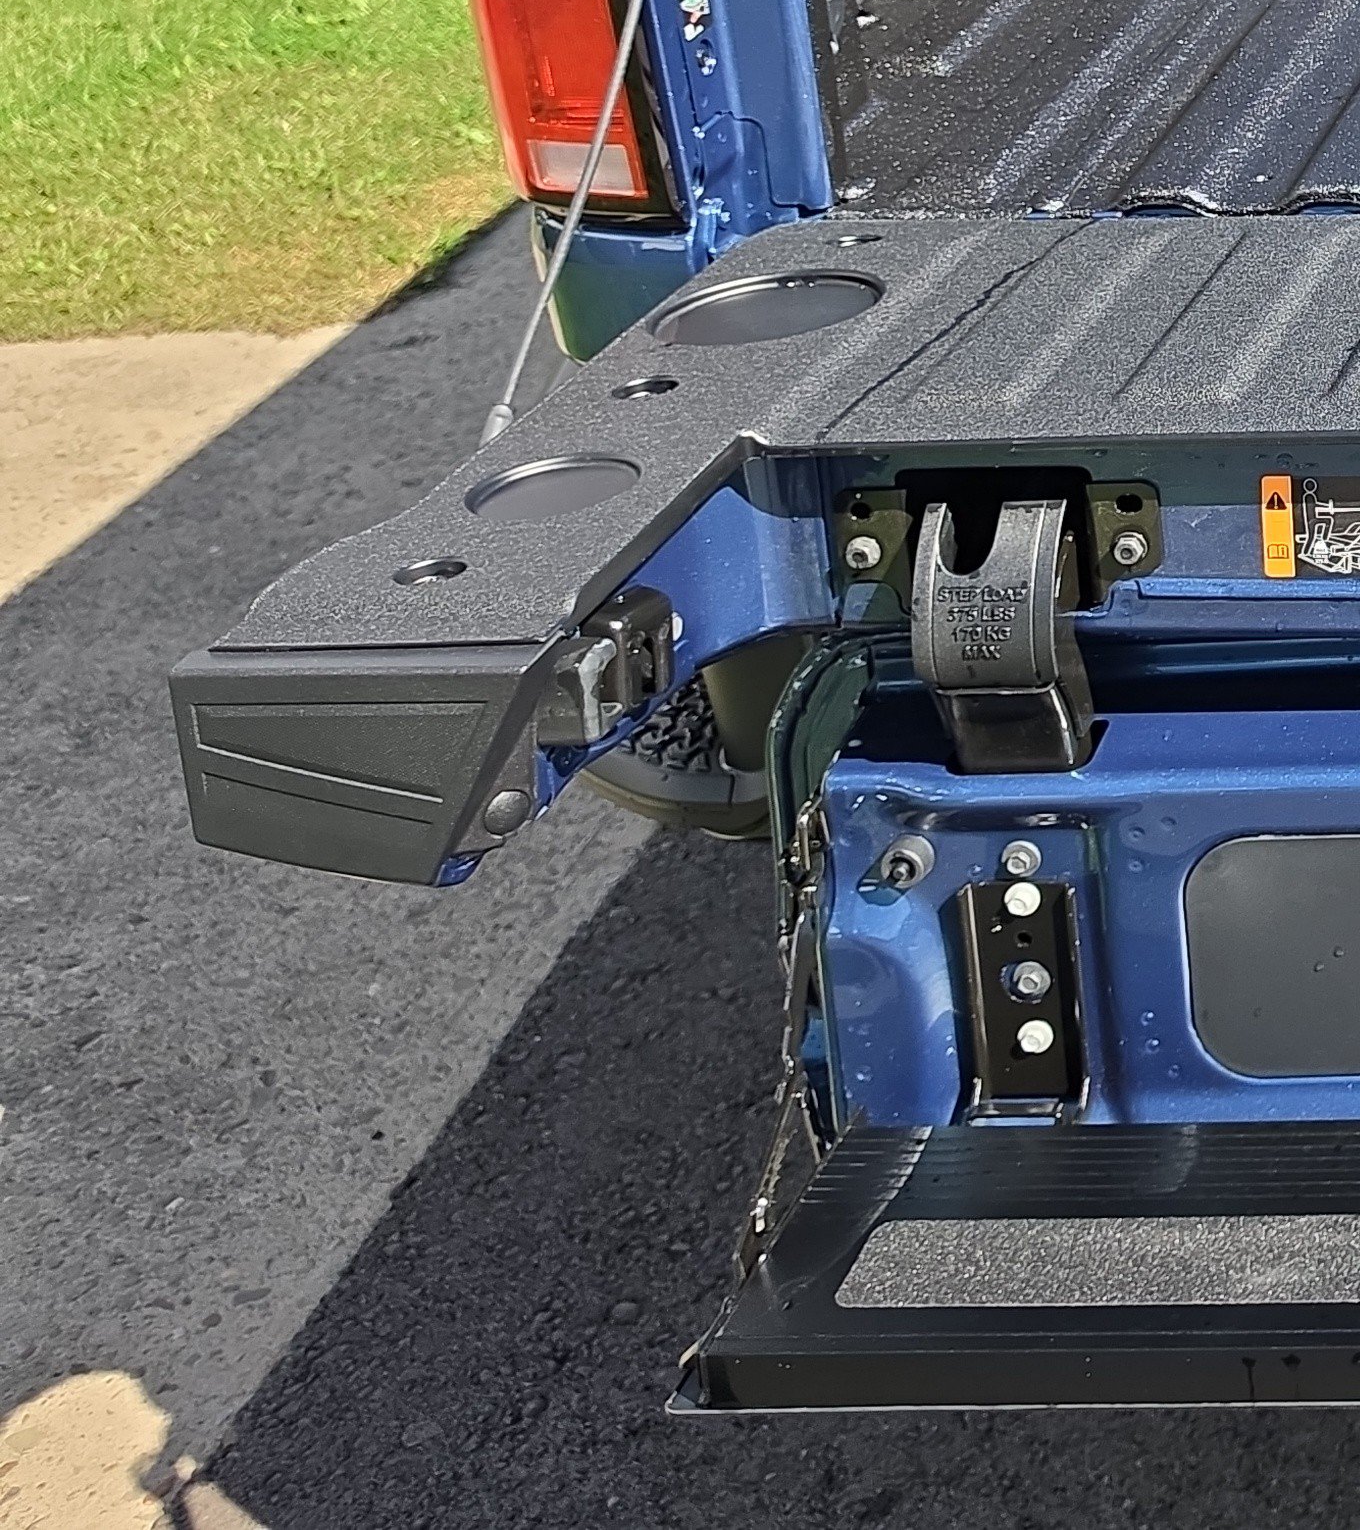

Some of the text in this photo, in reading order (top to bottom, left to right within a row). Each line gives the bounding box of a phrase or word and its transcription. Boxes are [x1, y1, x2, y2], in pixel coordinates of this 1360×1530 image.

[938, 586, 1028, 603] STEP LOAD
[985, 626, 1011, 642] KG
